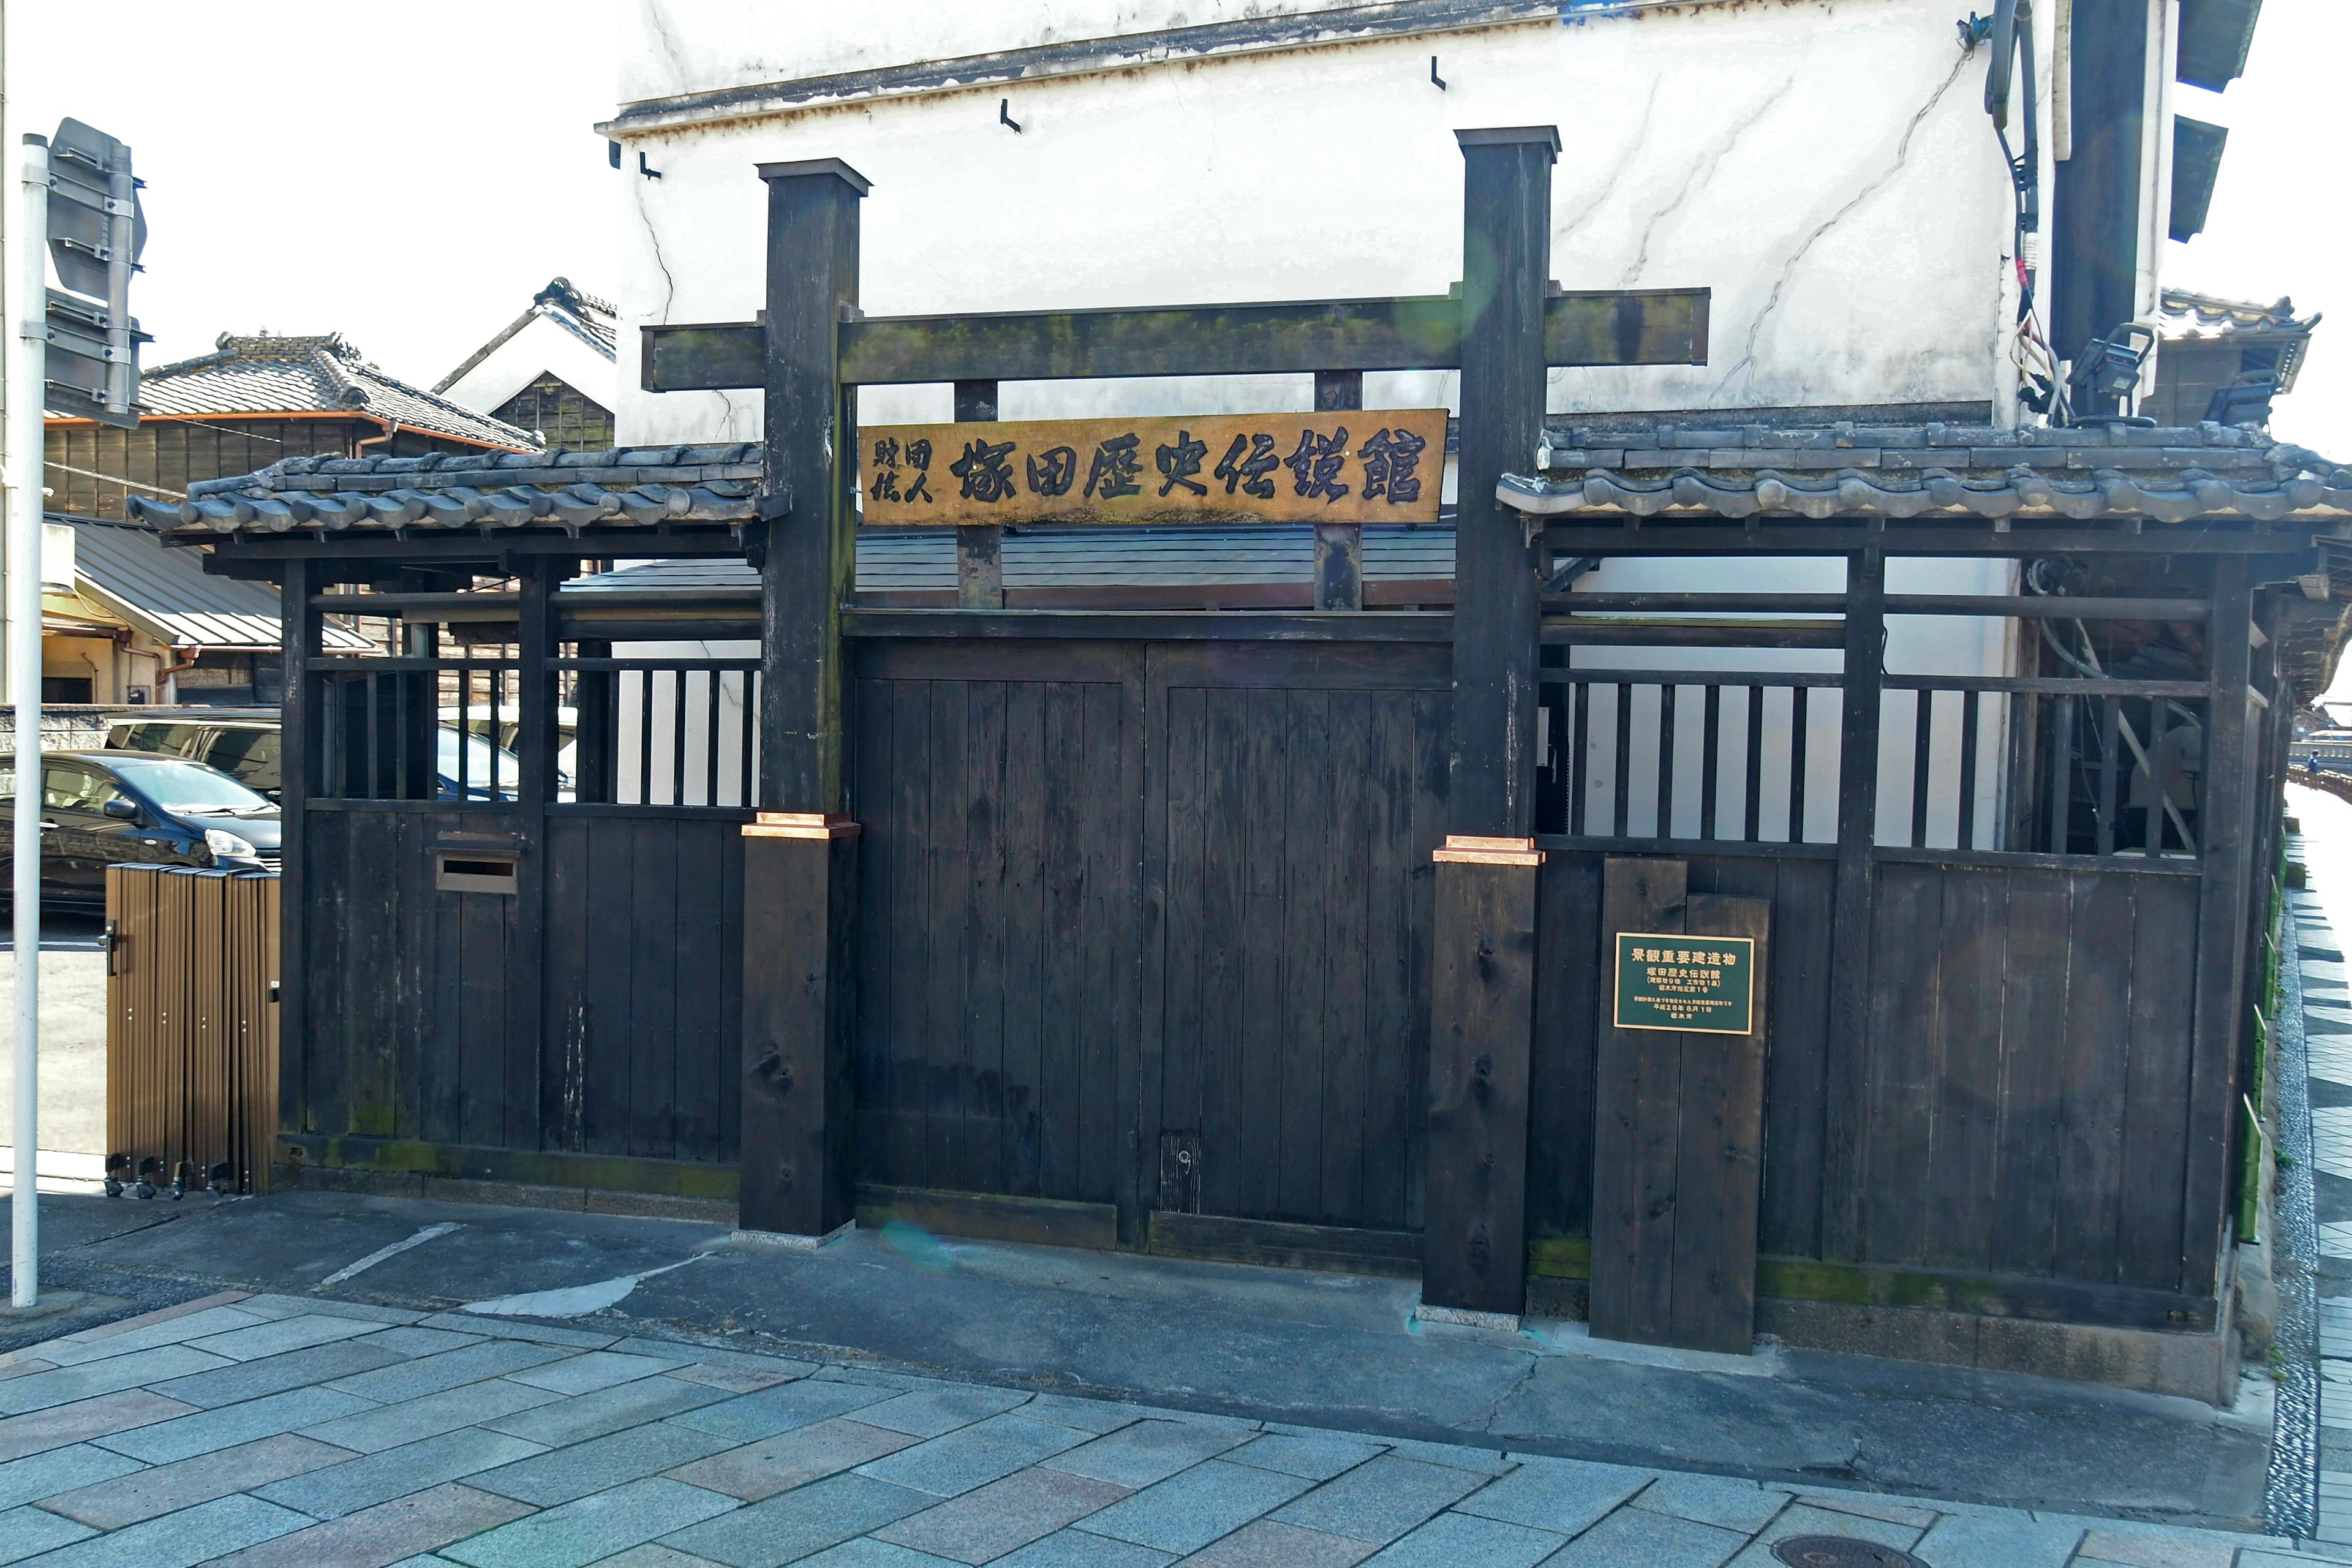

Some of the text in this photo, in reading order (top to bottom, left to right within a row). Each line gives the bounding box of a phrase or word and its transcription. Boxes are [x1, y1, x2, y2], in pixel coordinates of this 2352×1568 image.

[873, 437, 932, 471] 財団
[949, 426, 1426, 505] 塚田歴史伝説館
[870, 471, 933, 503] 法人
[1631, 948, 1736, 966] 景観重要建造物
[1646, 967, 1721, 979] 塚田歴史伝説館
